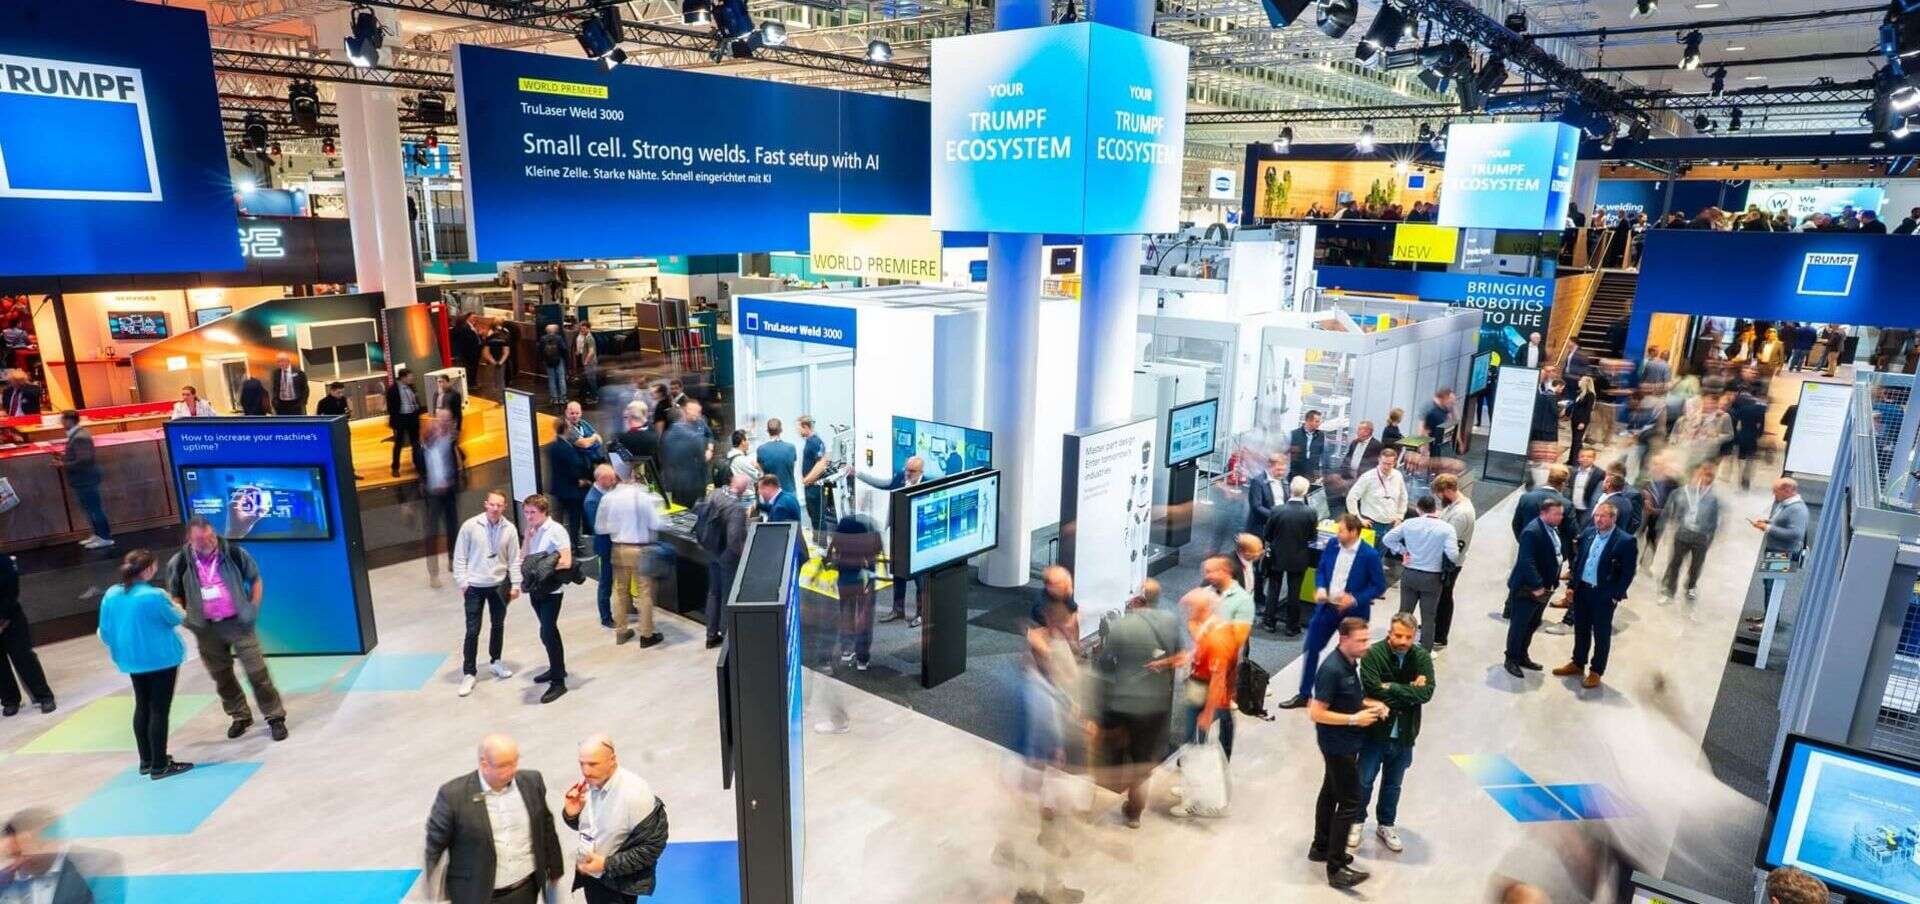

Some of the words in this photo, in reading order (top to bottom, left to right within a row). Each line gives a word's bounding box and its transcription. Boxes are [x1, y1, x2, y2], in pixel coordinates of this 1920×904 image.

[0, 63, 135, 100] RUMPF
[523, 80, 558, 92] WORLD
[561, 84, 602, 96] PREMIERE
[988, 83, 1024, 97] YOUR
[1129, 86, 1152, 101] YOUR
[520, 102, 567, 117] TruLaser
[569, 106, 597, 119] Weld
[600, 109, 624, 121] 3000
[969, 108, 1047, 131] TRUMPF
[1115, 111, 1165, 134] TRUMPF
[523, 132, 580, 156] Small
[588, 136, 627, 158] cell.
[632, 139, 693, 166] Strong
[698, 143, 750, 164] welds.
[755, 146, 785, 165] Fast
[789, 150, 828, 171] setup
[832, 152, 862, 169] with
[865, 154, 880, 170] AI
[946, 136, 1071, 161] ECOSYSTEM
[525, 166, 560, 178] Kleine
[562, 166, 591, 179] Zelle.
[594, 168, 625, 180] Starke
[628, 169, 659, 181] Nähte.
[662, 170, 693, 182] Schnell
[695, 171, 746, 184] eingerichtet
[748, 173, 761, 183] mit
[763, 174, 772, 183] KI
[1472, 163, 1525, 176] TRUMPF
[1453, 178, 1540, 191] COSYSTEM
[1606, 203, 1643, 213] welding
[1397, 245, 1432, 259] NEW
[1808, 255, 1855, 264] TRUMPF
[814, 254, 862, 271] WORLD
[868, 257, 936, 276] PREMIERE
[1468, 281, 1546, 298] BRINGING
[1465, 296, 1544, 312] ROBOTICS
[1485, 311, 1505, 324] TO
[1510, 313, 1543, 327] LIFE
[763, 320, 798, 334] TruLaser
[799, 325, 821, 337] Weld
[823, 329, 843, 340] 3000
[181, 433, 202, 441] How
[216, 433, 251, 441] increase
[254, 434, 273, 443] your
[275, 432, 318, 441] machine's
[183, 443, 218, 451] uptime?
